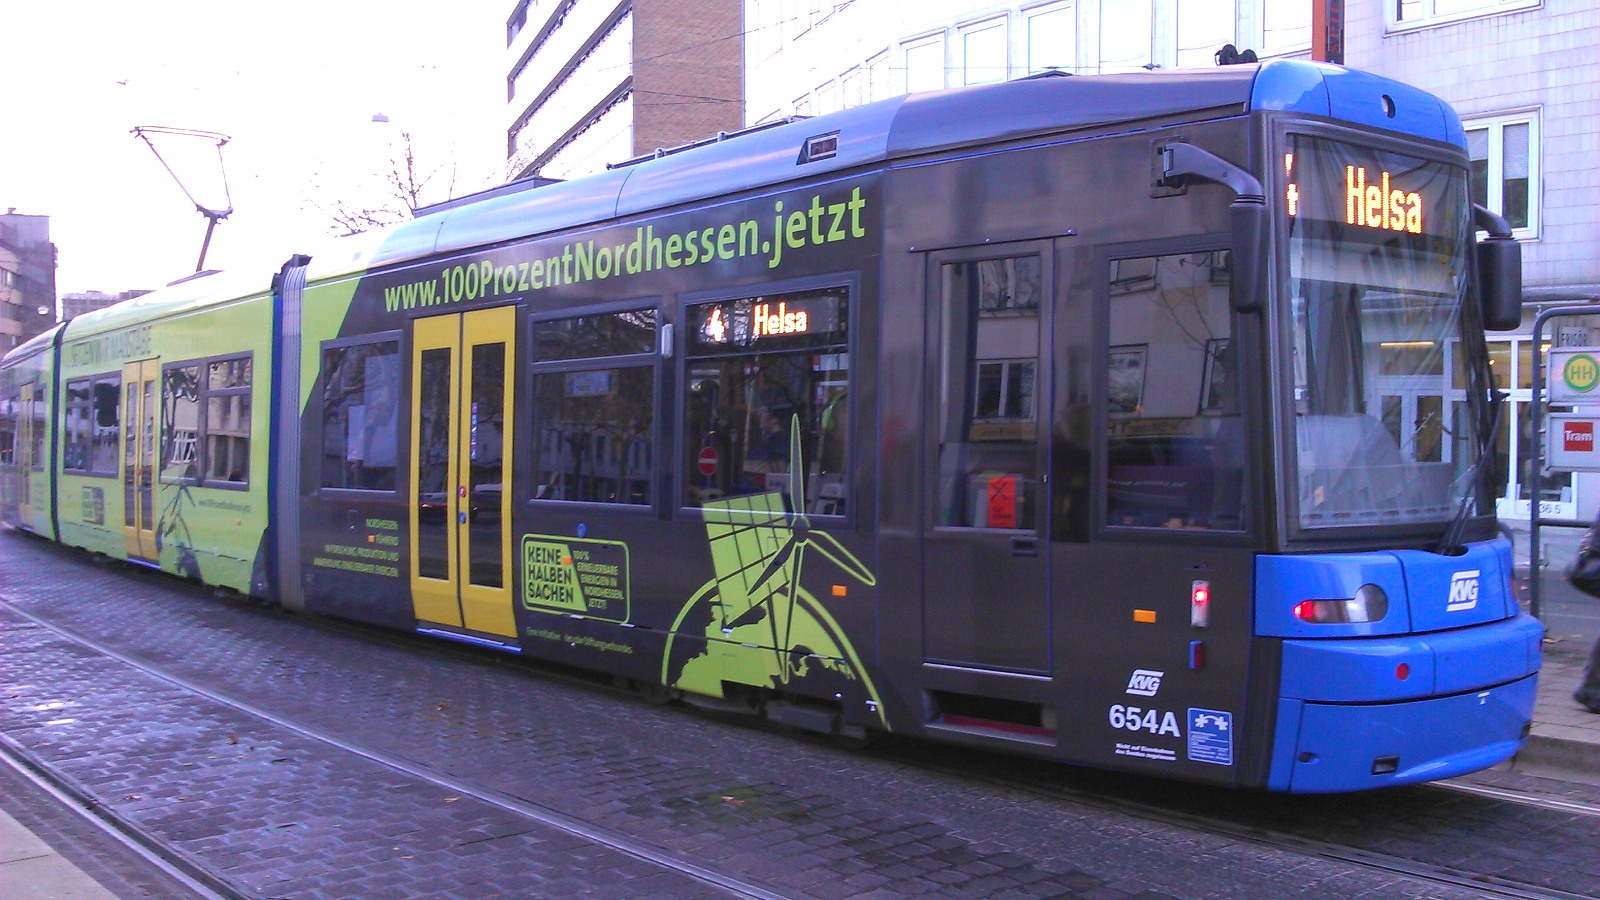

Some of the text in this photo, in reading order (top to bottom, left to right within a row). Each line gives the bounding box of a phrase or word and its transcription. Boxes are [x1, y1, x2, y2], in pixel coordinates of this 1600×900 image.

[1346, 165, 1424, 235] Helsa
[384, 186, 866, 313] www.100ProzentNordhessen.jetzt
[753, 301, 808, 336] Helsa
[1564, 430, 1593, 442] Tram
[527, 545, 561, 565] KEINE
[527, 563, 572, 585] HALBEN
[527, 581, 574, 603] SACHEN
[1448, 576, 1480, 606] KVG
[1127, 672, 1162, 693] KVG
[1108, 704, 1182, 738] 654A
